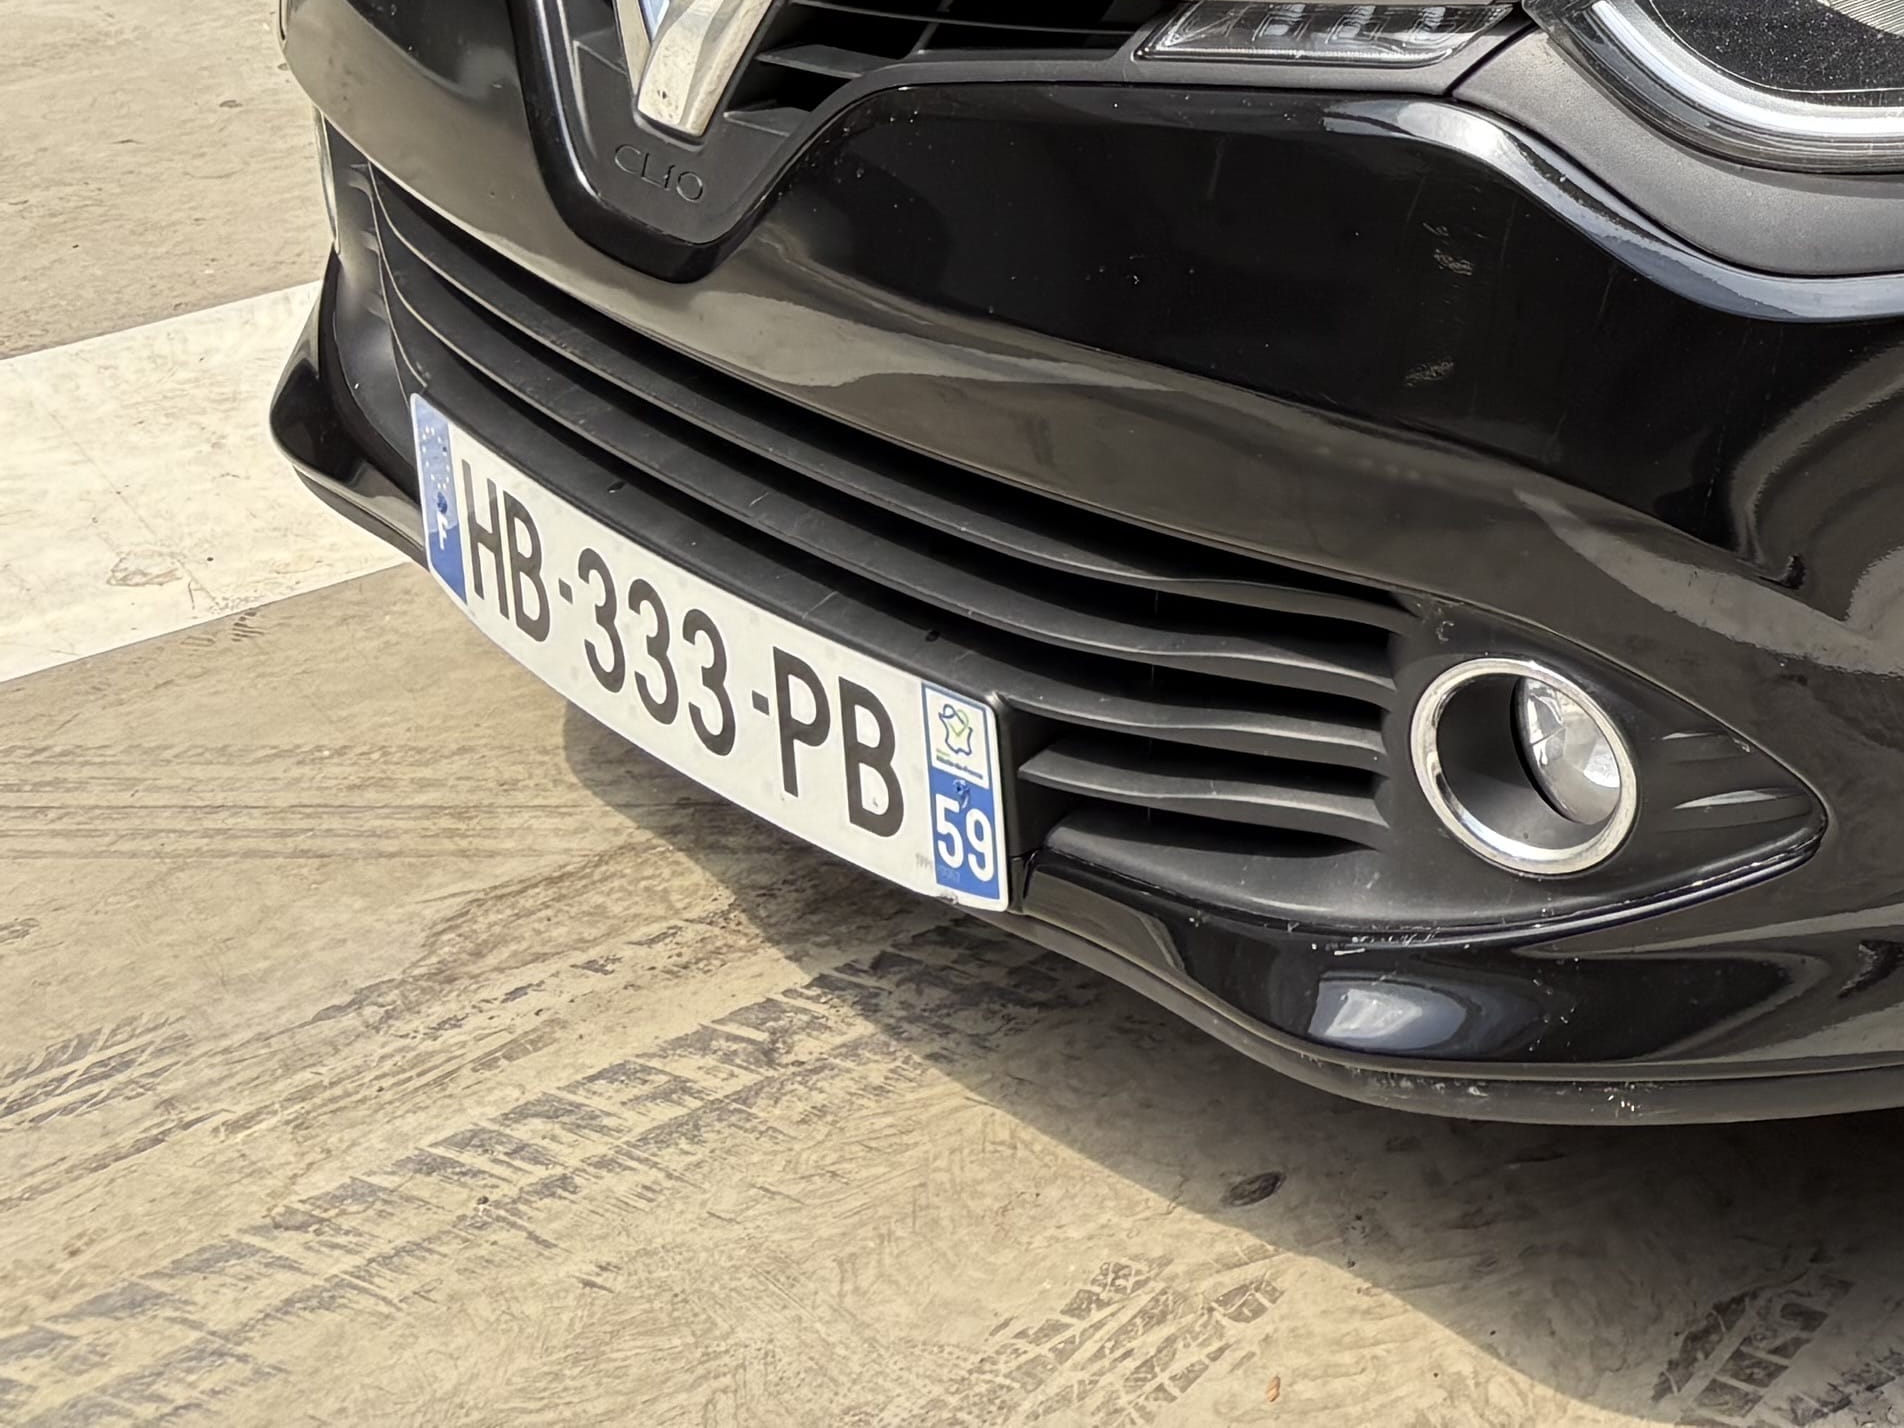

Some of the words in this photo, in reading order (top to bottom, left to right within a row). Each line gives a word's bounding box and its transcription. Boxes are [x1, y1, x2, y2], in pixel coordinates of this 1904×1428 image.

[613, 143, 705, 204] CLIO
[436, 516, 450, 552] F
[461, 458, 906, 840] HB-333-PB
[935, 793, 994, 882] 59
